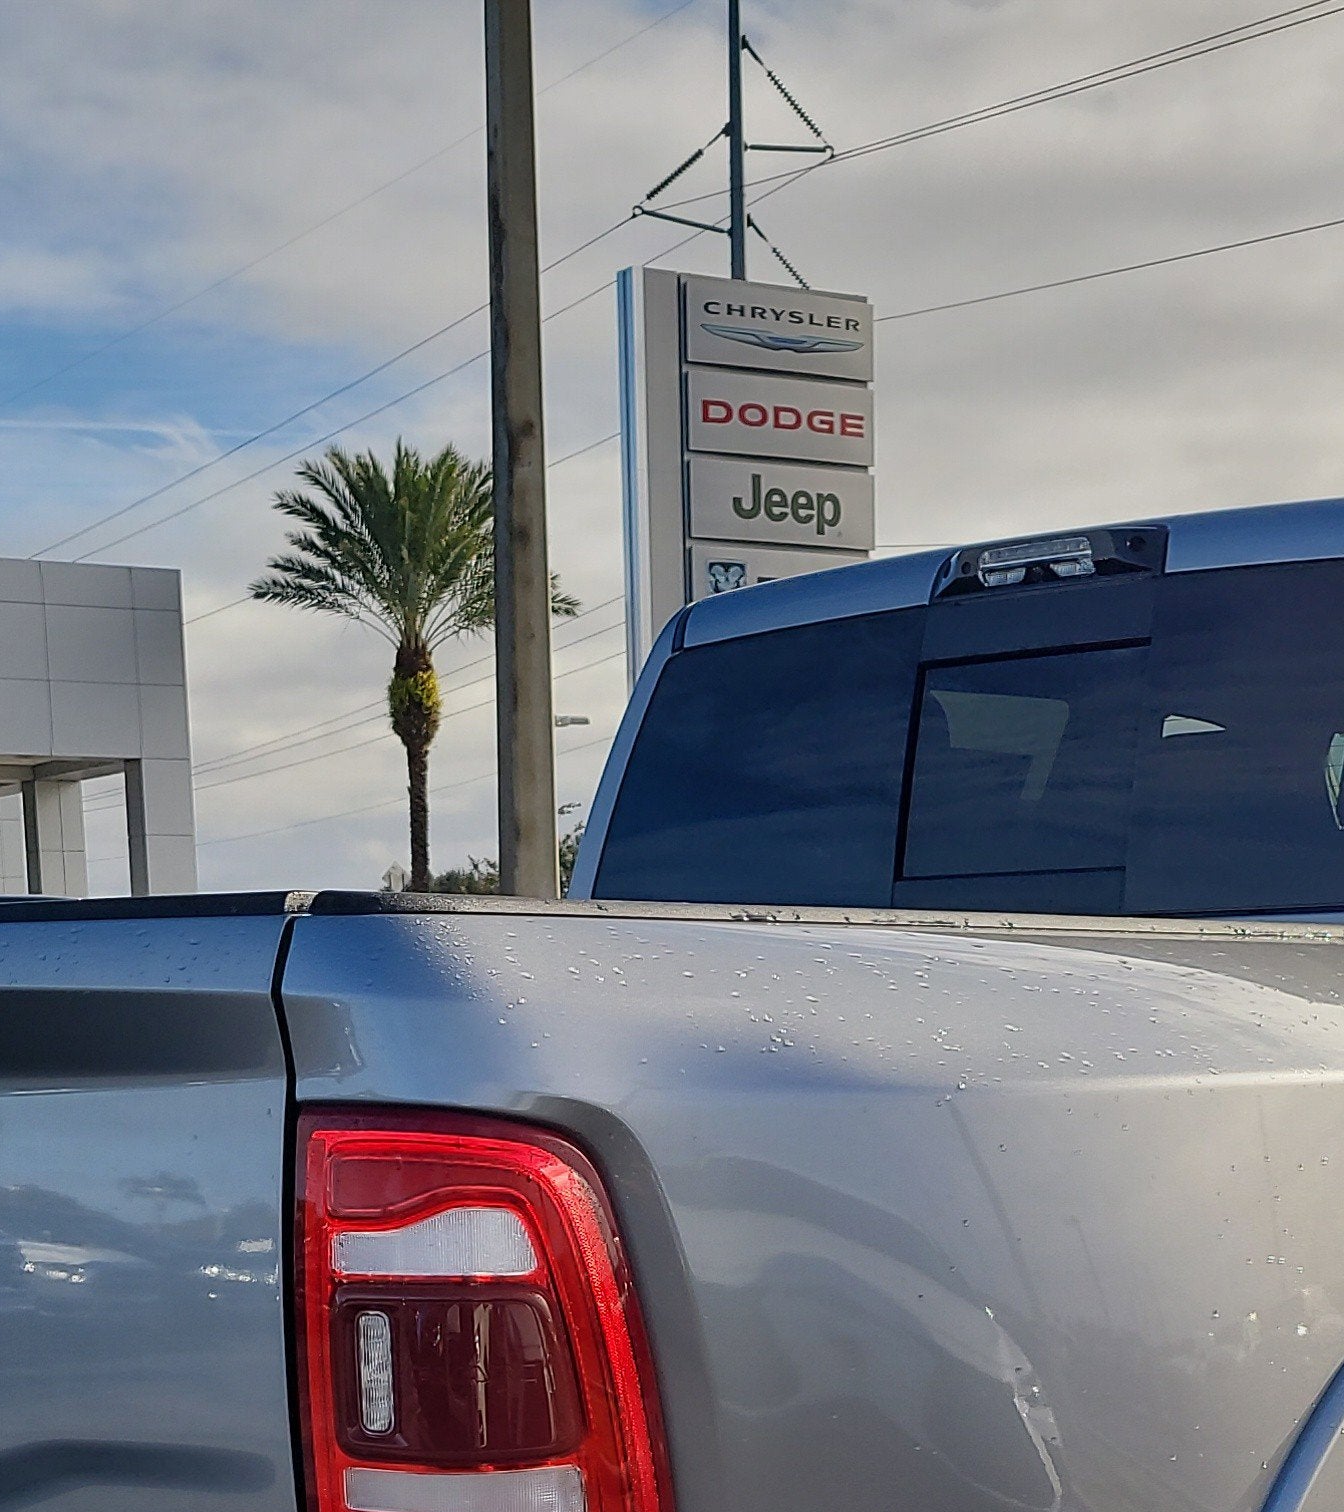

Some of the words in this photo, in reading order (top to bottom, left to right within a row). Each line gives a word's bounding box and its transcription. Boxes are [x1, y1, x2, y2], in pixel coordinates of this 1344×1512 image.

[703, 301, 861, 332] CHRYSLER
[701, 399, 864, 438] DODGE
[732, 473, 841, 535] Jeep
